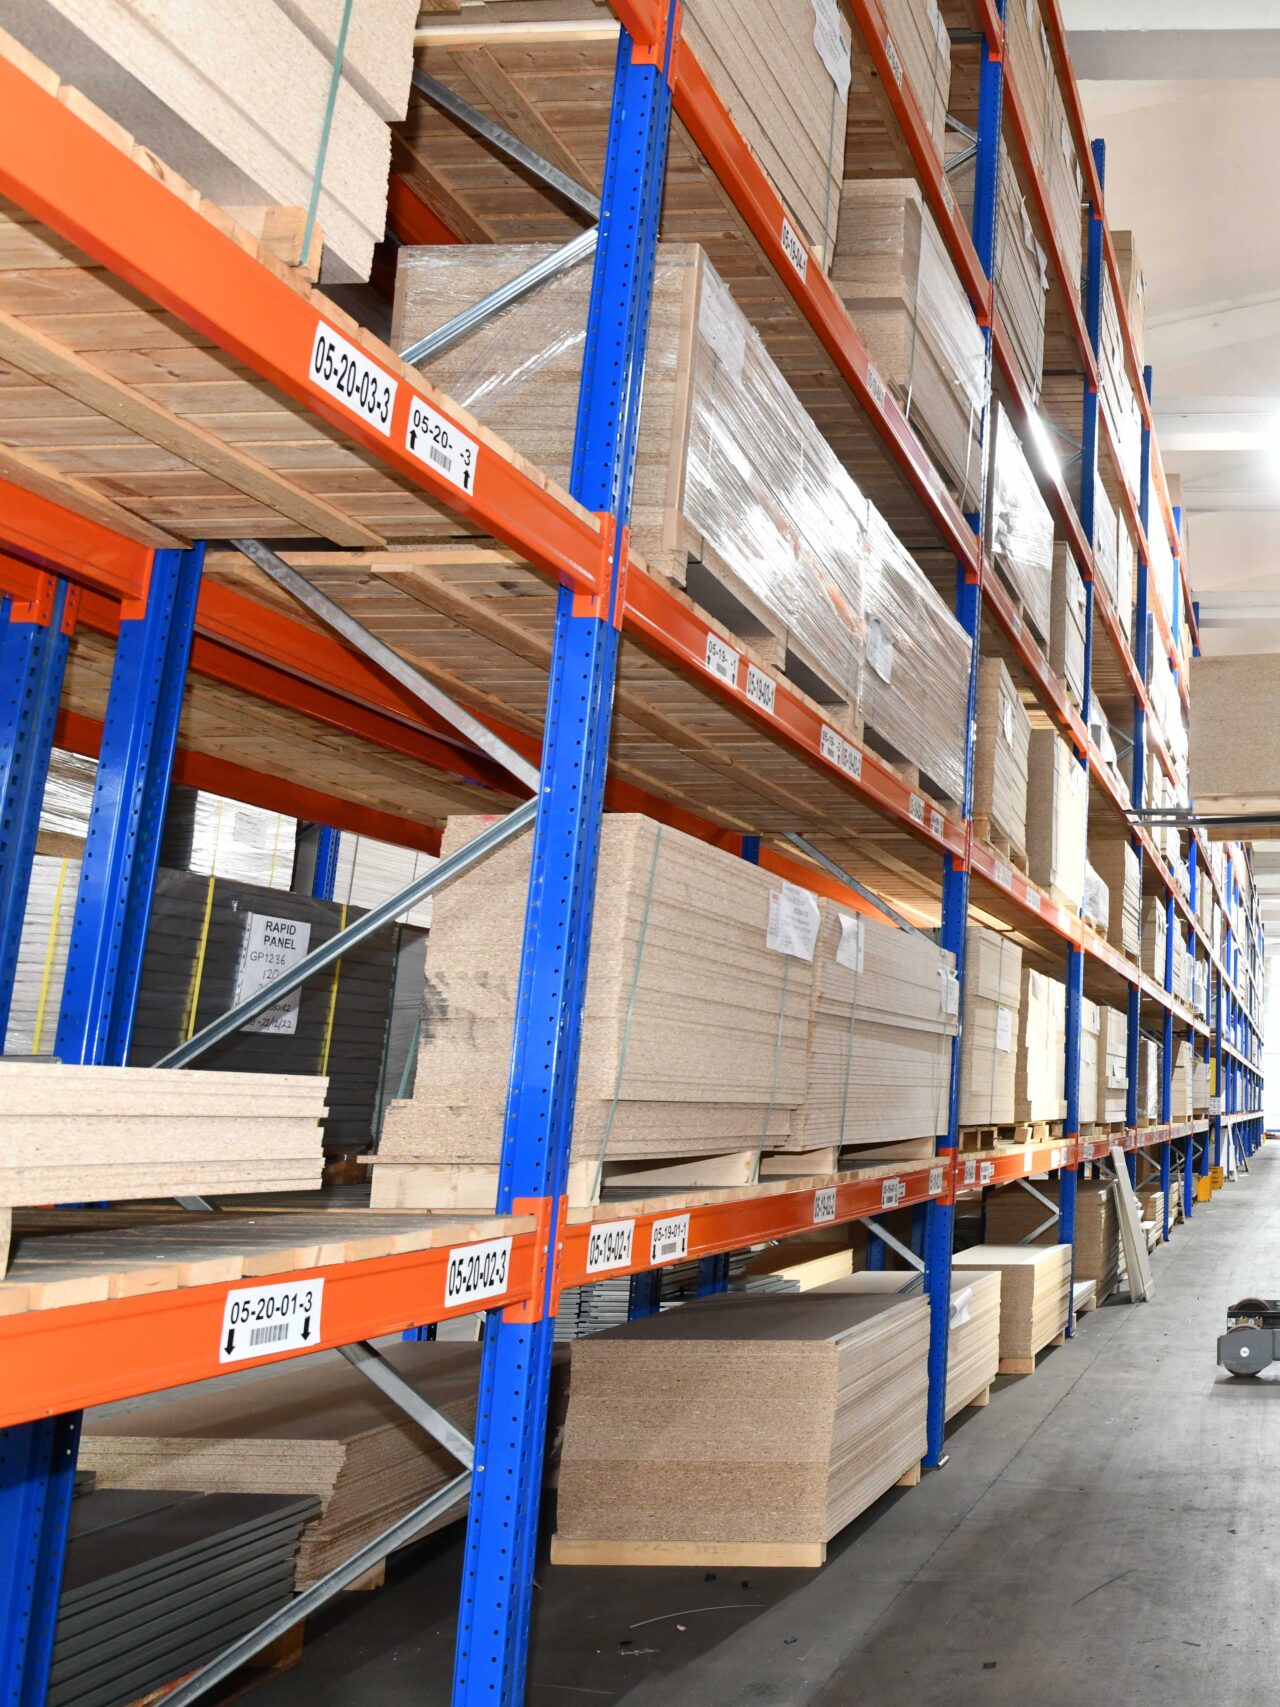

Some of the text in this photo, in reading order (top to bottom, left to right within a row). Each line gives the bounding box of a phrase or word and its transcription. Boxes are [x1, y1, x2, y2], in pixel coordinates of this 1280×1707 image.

[782, 225, 806, 280] 05-19-04-1
[314, 336, 390, 423] 05-20-03-3
[413, 409, 471, 466] 05-20- -3
[264, 935, 296, 950] PANEL
[265, 921, 296, 936] RAPID
[250, 951, 285, 965] GP1236
[589, 1228, 632, 1265] 05-19-02-1
[653, 1222, 687, 1242] 05-19-01-1
[449, 1249, 507, 1296] 05-20-02-3
[230, 1291, 314, 1324] 05-20-01-3
